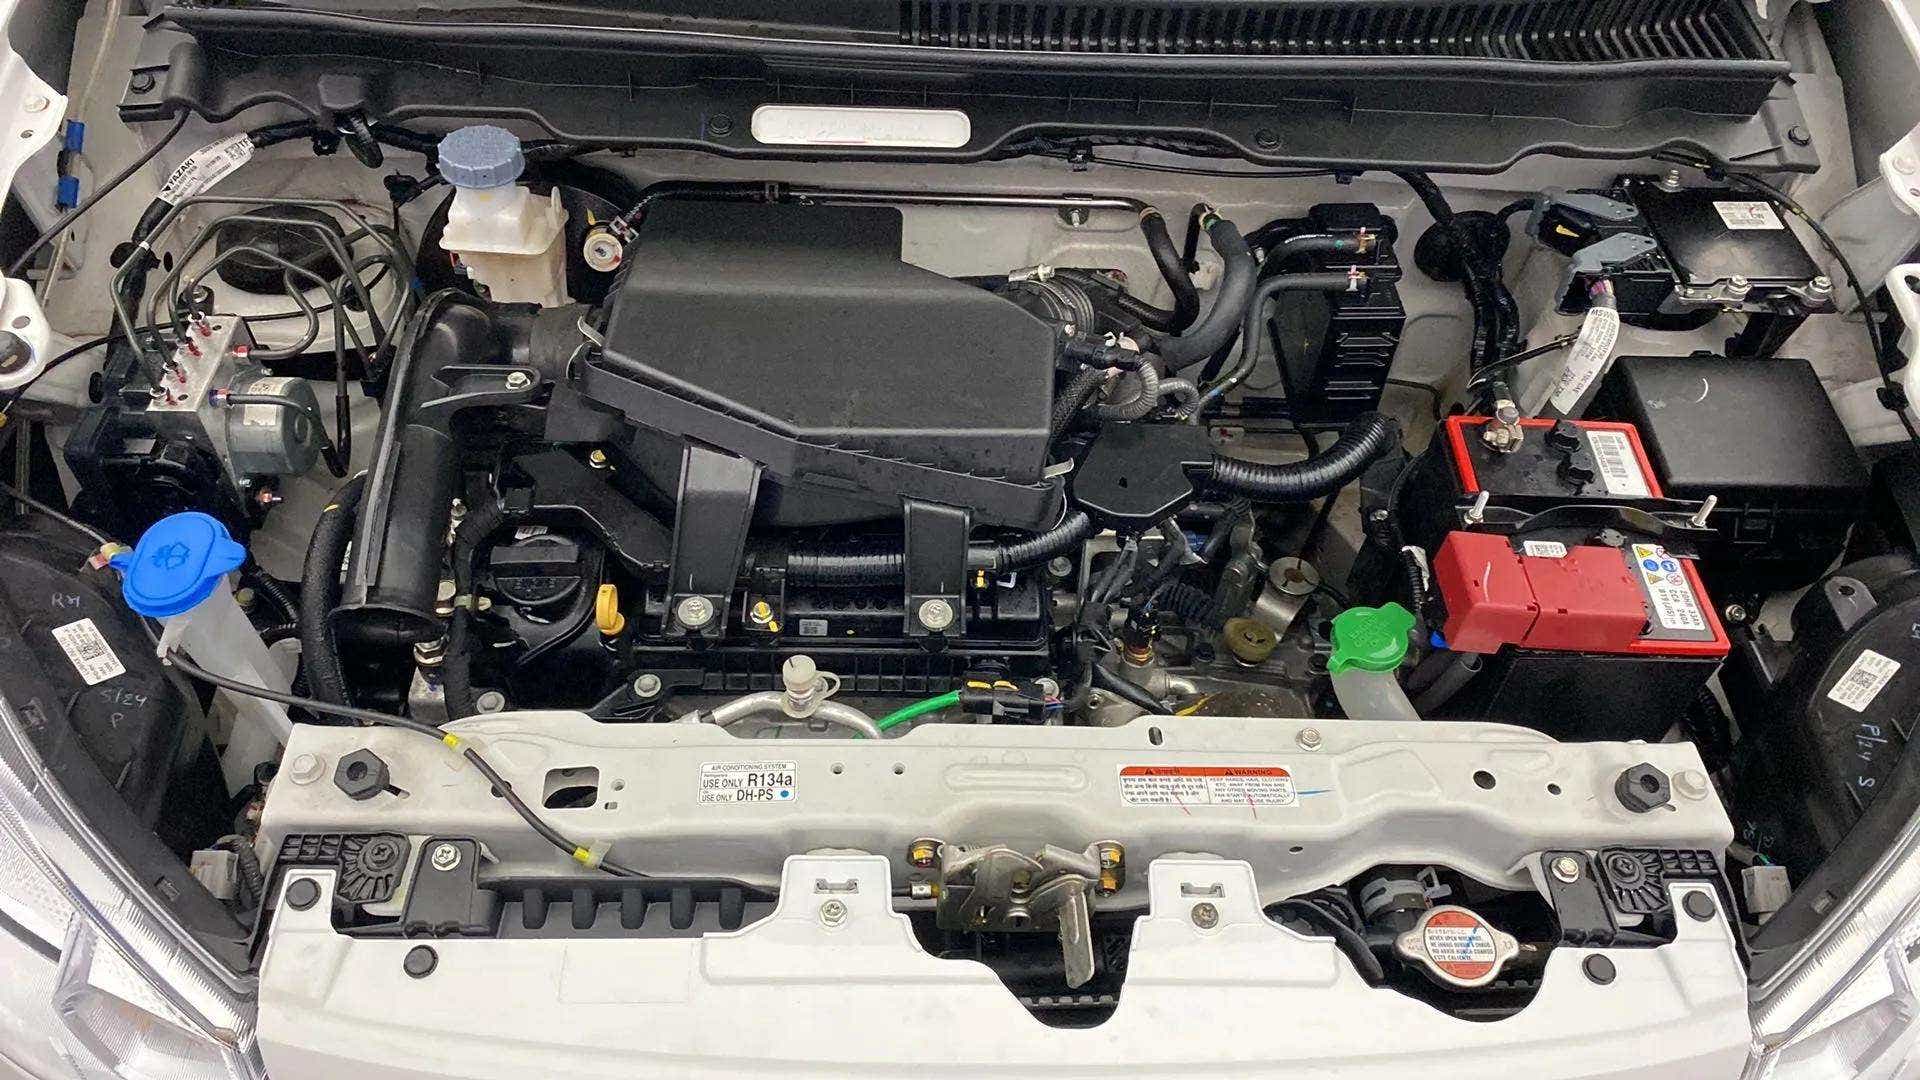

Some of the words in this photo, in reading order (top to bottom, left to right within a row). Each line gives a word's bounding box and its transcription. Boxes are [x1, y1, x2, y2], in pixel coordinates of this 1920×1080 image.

[168, 158, 195, 185] YAZAKI
[1234, 768, 1273, 776] WARNING
[703, 779, 719, 788] USE
[721, 778, 743, 788] ONLY
[748, 773, 792, 787] R134a
[702, 794, 716, 802] USE
[716, 794, 732, 802] ONLY
[737, 788, 774, 801] DH-PS
